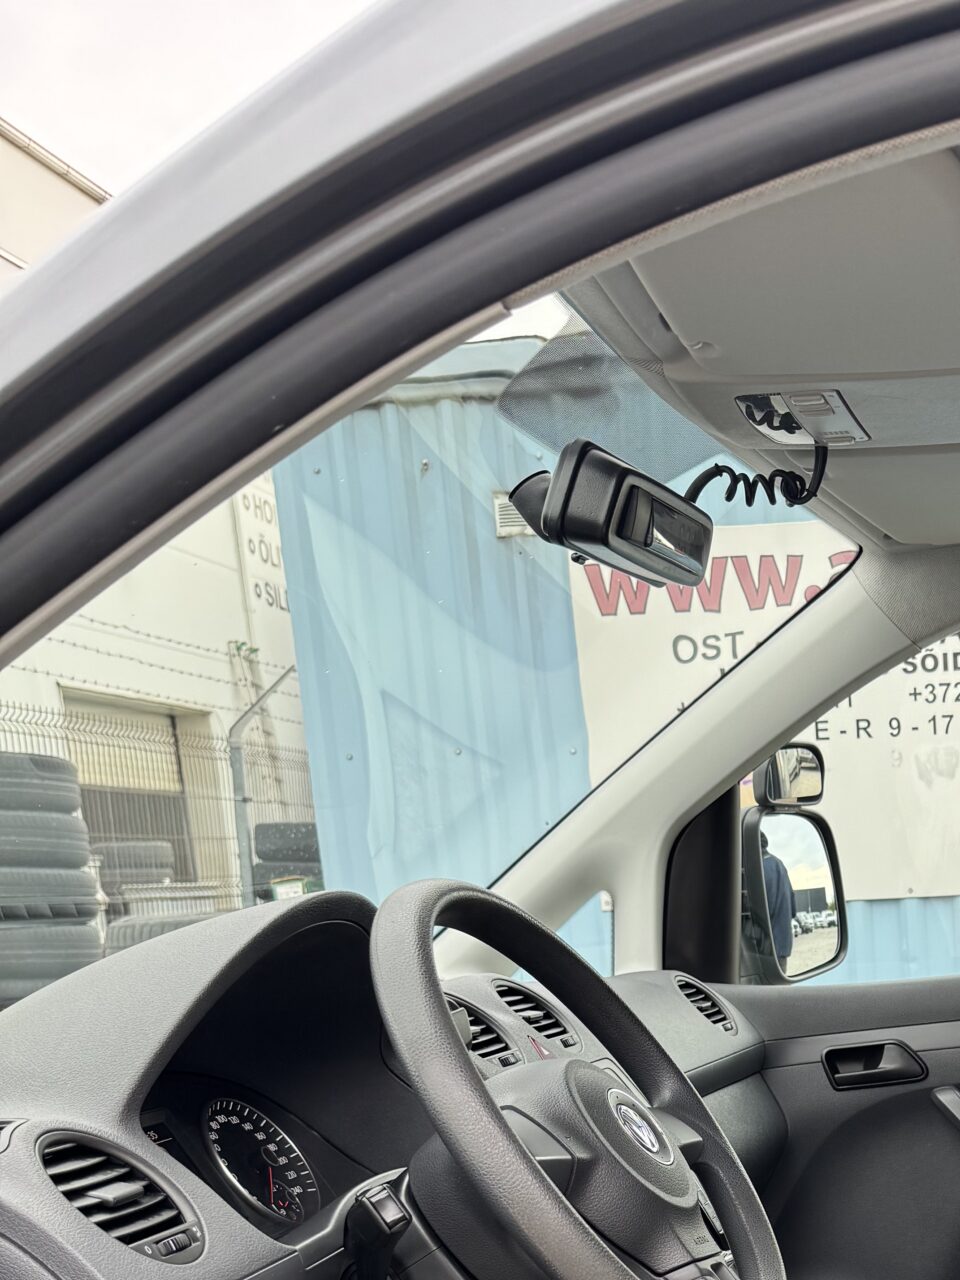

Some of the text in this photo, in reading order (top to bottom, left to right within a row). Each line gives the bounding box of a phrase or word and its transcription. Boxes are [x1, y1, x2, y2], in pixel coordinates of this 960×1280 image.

[672, 631, 744, 664] OST
[815, 720, 830, 740] E
[856, 718, 872, 739] R
[889, 717, 901, 737] 9
[928, 715, 954, 735] 17
